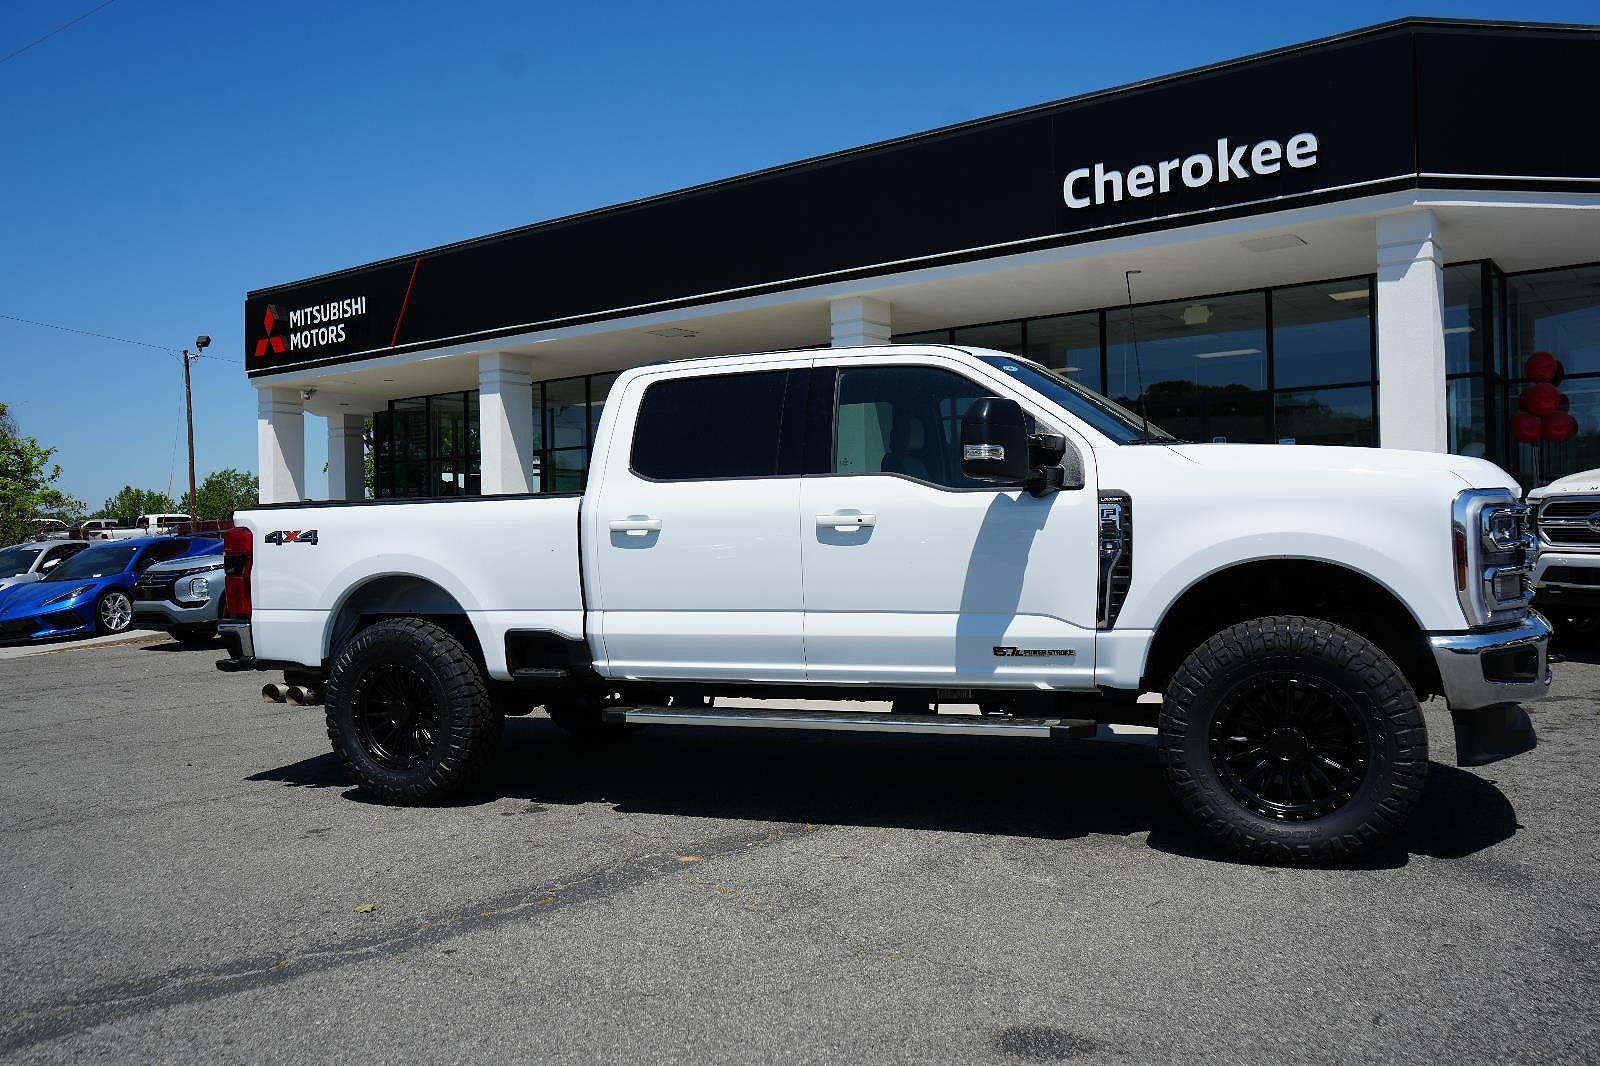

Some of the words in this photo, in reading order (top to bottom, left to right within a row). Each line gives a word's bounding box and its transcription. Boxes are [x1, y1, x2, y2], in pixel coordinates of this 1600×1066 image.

[1063, 132, 1318, 209] Cherokee
[289, 296, 366, 328] MITSUBISHI
[290, 323, 346, 350] MOTORS
